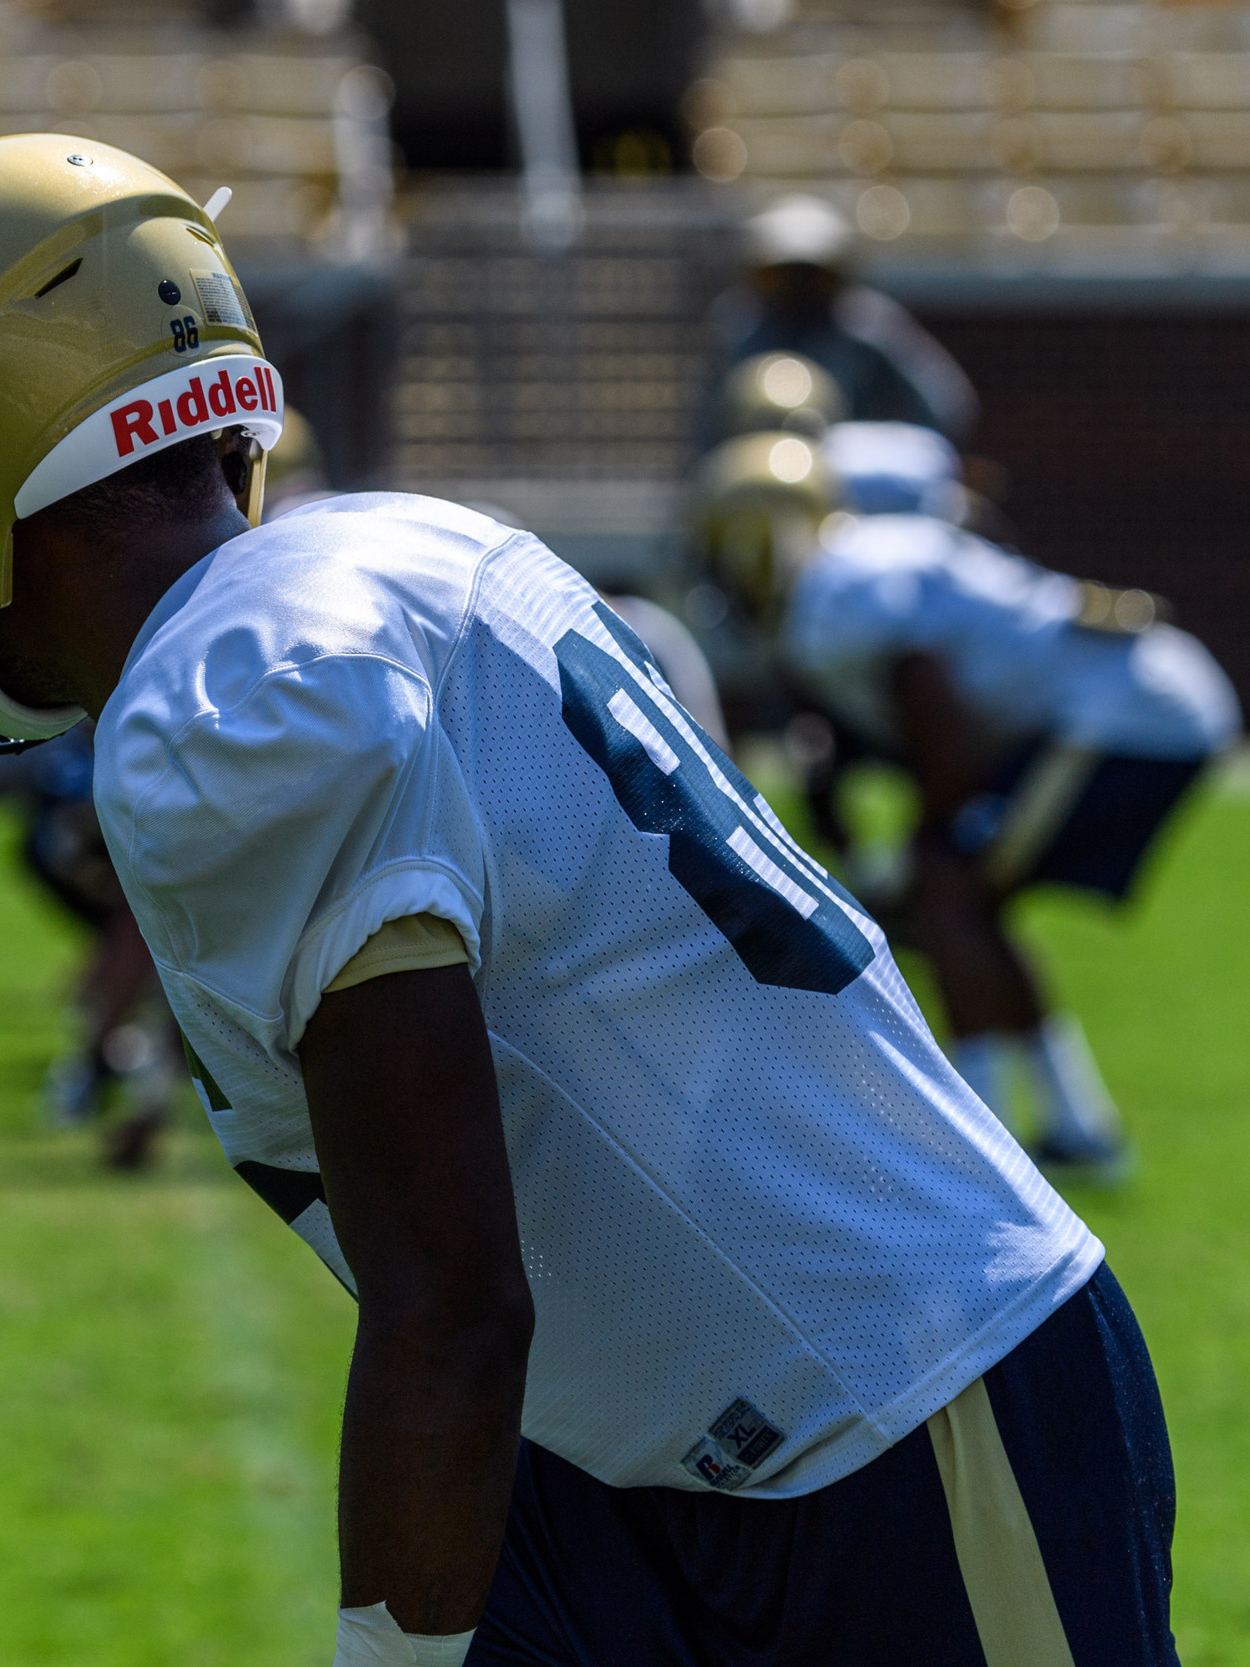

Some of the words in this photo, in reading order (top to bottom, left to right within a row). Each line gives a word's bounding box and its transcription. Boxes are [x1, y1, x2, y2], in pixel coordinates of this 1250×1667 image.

[170, 315, 199, 352] 86
[110, 366, 277, 457] Riddell
[727, 1423, 757, 1450] XL
